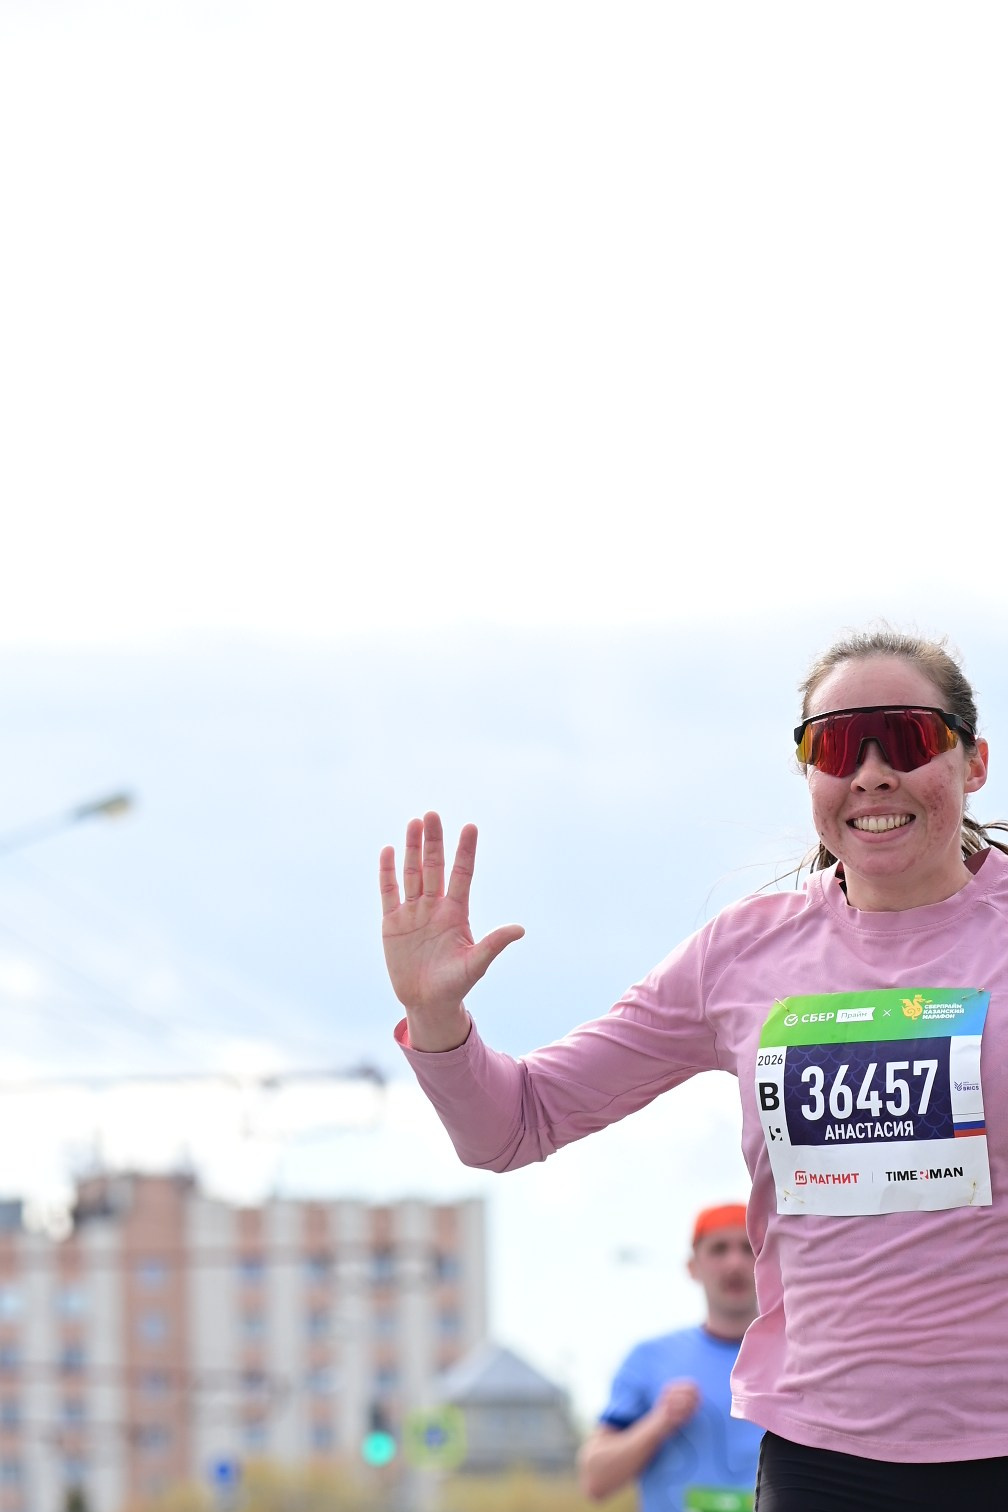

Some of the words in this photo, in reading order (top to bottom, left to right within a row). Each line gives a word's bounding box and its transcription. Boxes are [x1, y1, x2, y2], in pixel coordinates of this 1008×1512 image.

[801, 1012, 835, 1023] СБЕР
[757, 1054, 784, 1066] 2026
[800, 1059, 939, 1122] 36457
[824, 1121, 915, 1141] АНАСТАСИЯ
[809, 1173, 860, 1184] МАГНИТ
